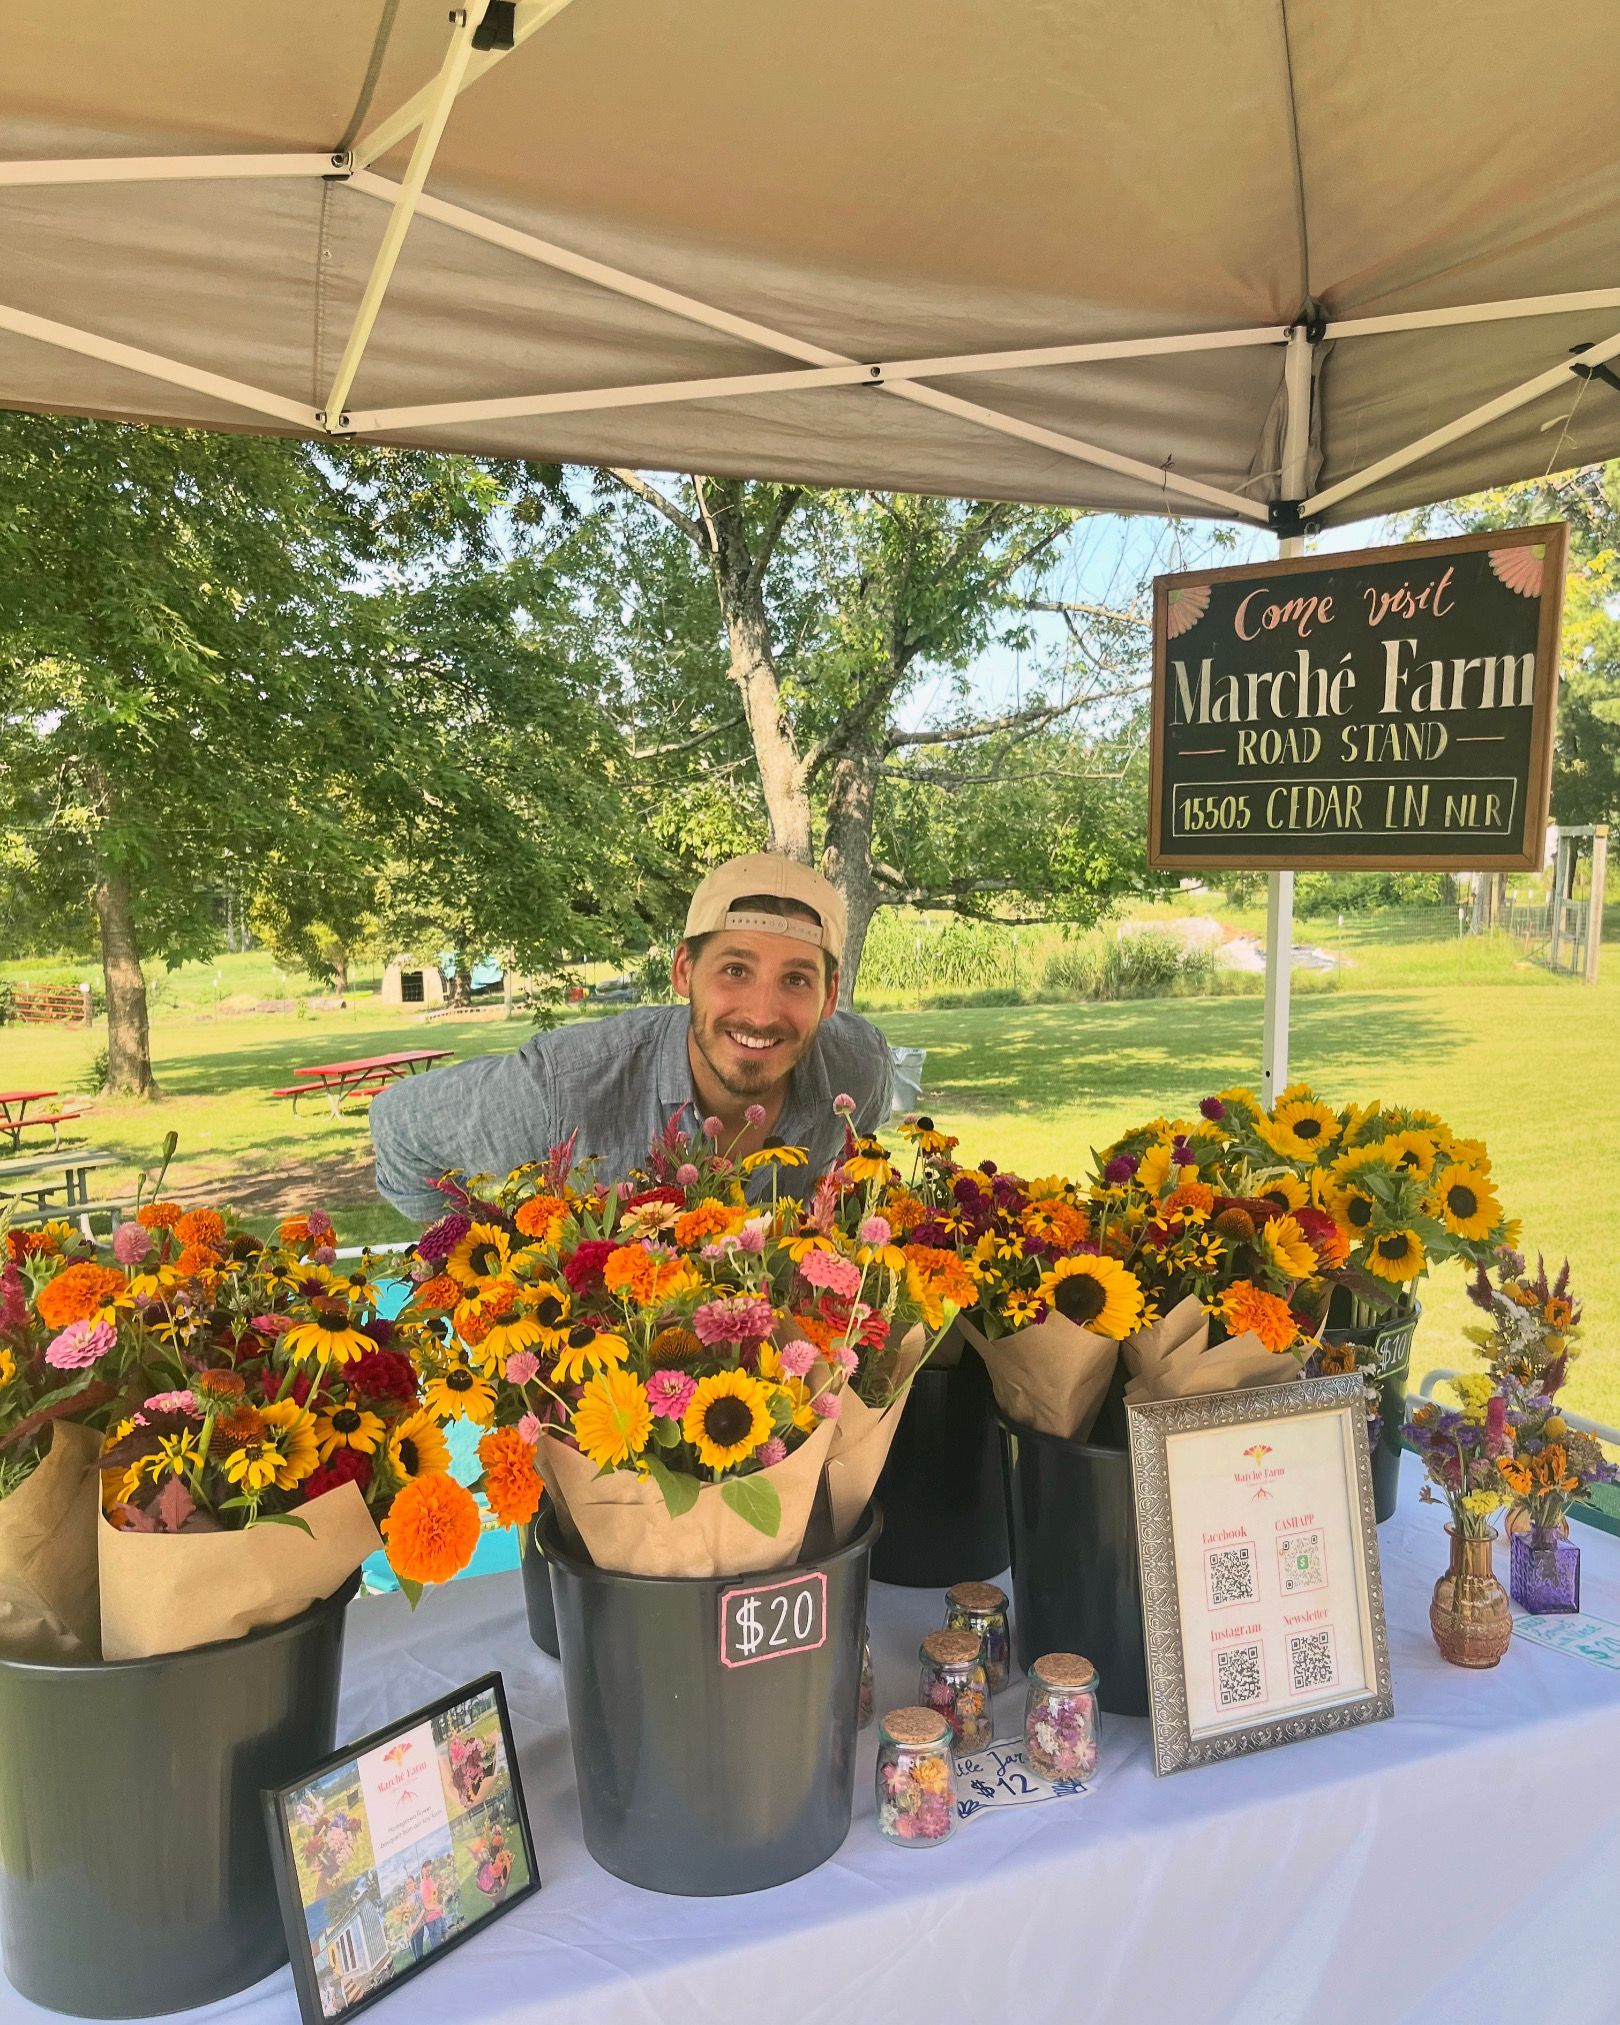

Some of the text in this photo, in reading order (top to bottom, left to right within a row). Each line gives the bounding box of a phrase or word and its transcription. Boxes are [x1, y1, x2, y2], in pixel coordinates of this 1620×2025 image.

[1234, 567, 1454, 641] Come visit
[1169, 639, 1535, 726] Marché Farm
[1237, 722, 1448, 766] ROAD STAND
[1179, 785, 1502, 831] 15505 CEDAR LN NLR
[1380, 1333, 1408, 1371] $10
[1202, 1525, 1248, 1545] Facebook
[1275, 1514, 1315, 1531] CASHAPP
[735, 1590, 813, 1657] $20
[1211, 1624, 1262, 1642] Instagram
[1282, 1608, 1329, 1626] Newsletter
[956, 1751, 1025, 1776] tle Jar
[970, 1773, 1039, 1799] $12
